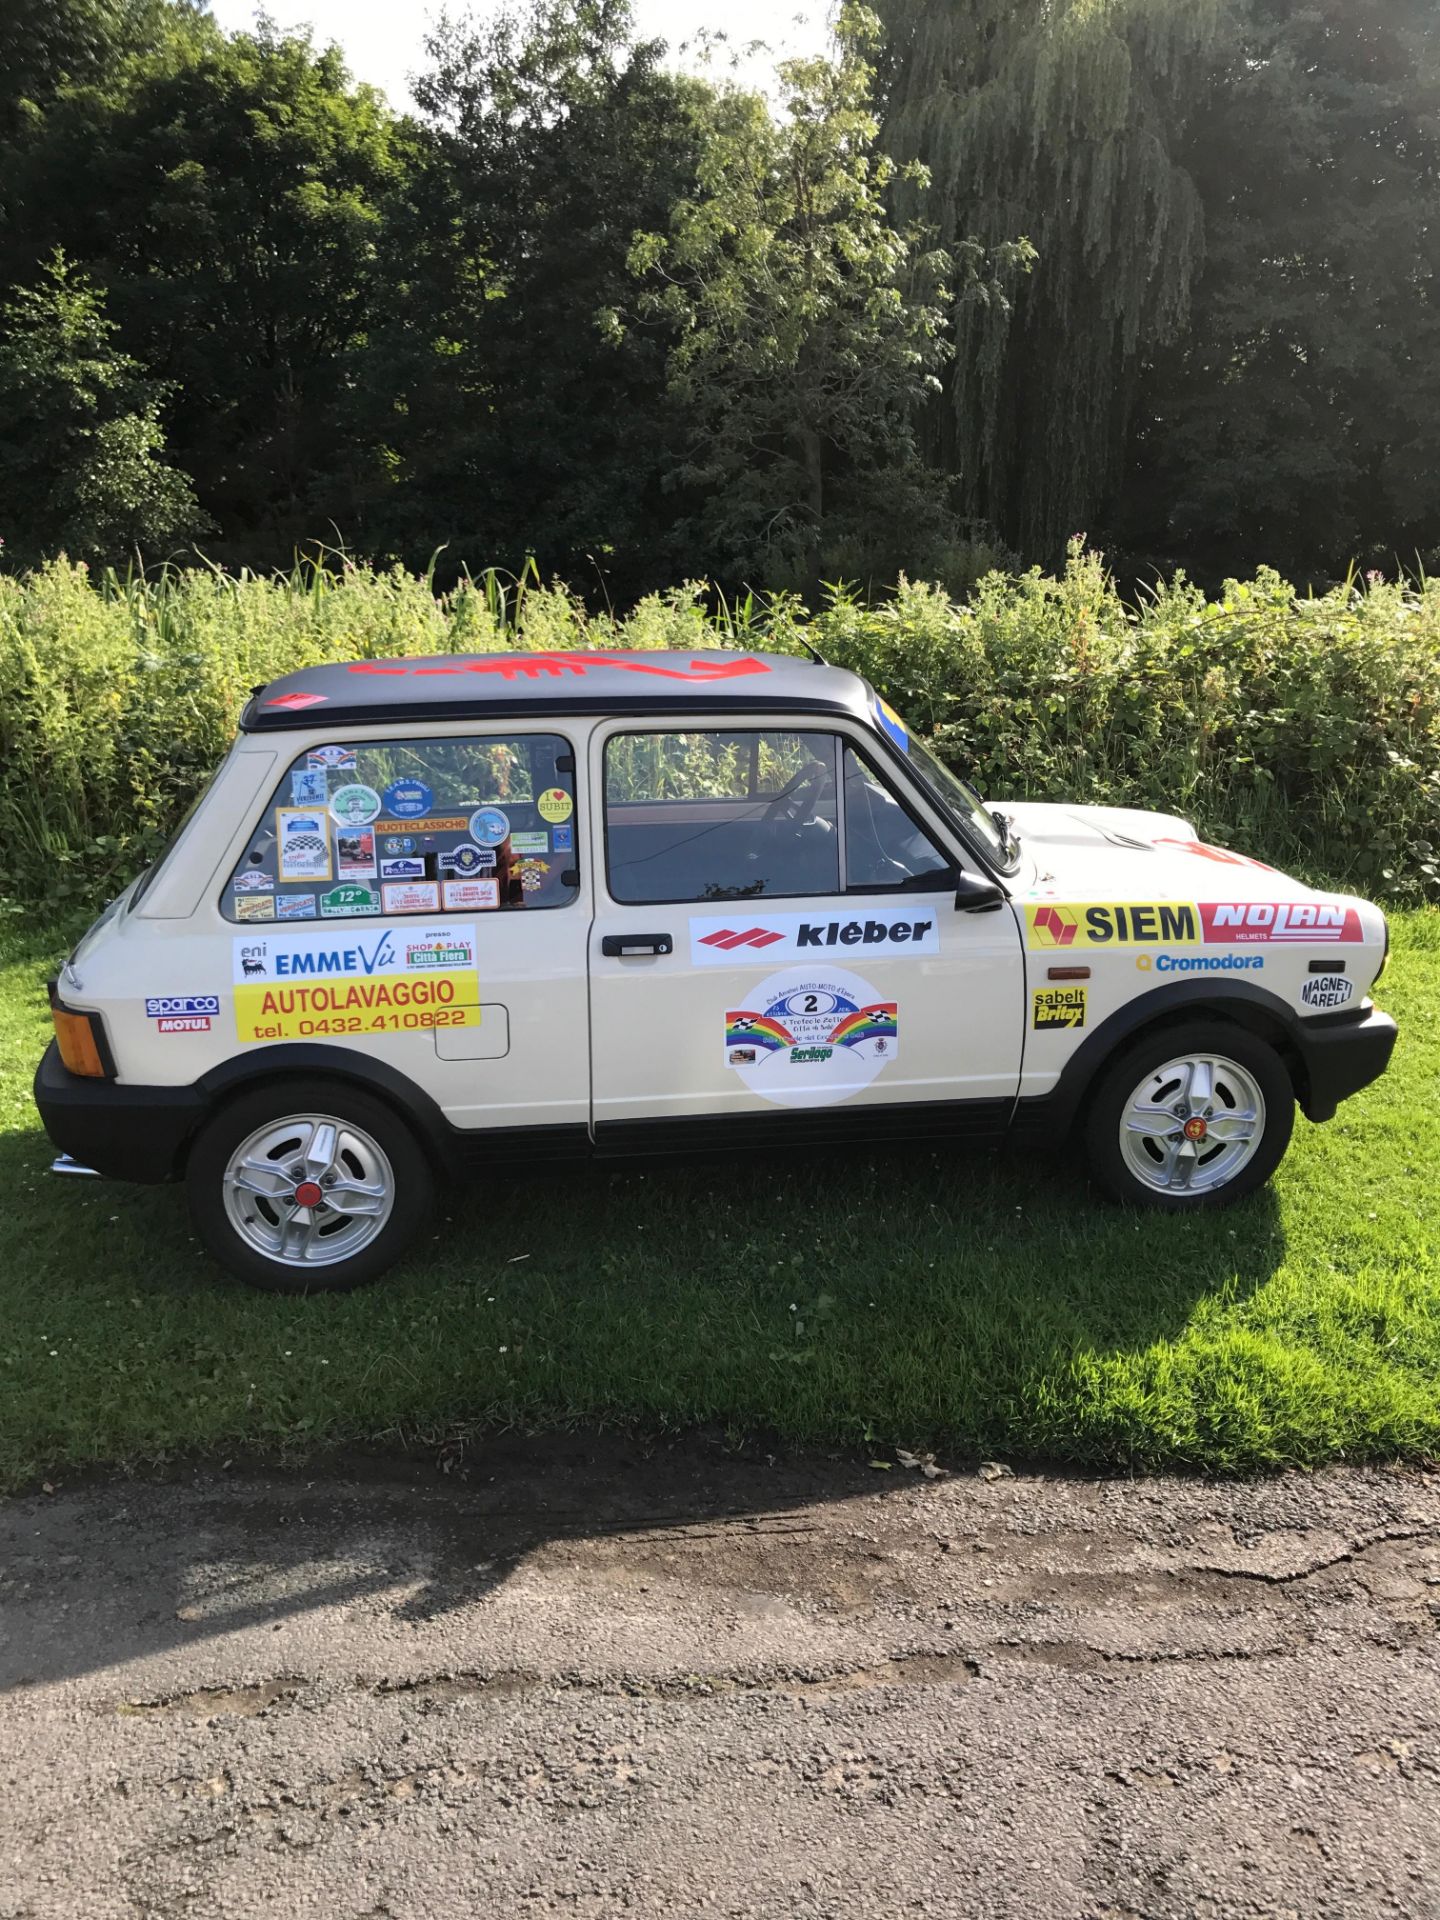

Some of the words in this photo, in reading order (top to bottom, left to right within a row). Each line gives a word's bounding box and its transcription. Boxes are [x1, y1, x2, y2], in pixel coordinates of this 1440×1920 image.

[544, 792, 551, 802] I
[540, 802, 571, 811] SUBIT
[376, 820, 466, 832] RUOTECLASSICHE
[1086, 906, 1196, 943] SIEM
[1212, 904, 1347, 934] NOLAN
[796, 920, 933, 947] kléber
[241, 942, 267, 957] eni
[406, 944, 433, 952] SHOP
[446, 941, 471, 949] PLAY
[413, 951, 438, 963] Città
[440, 950, 465, 961] Fiera
[1156, 954, 1265, 972] Cromodora
[261, 979, 455, 1015] AUTOLAVAGGIO
[804, 995, 818, 1012] 2
[1035, 989, 1085, 1005] sabelt
[147, 997, 217, 1015] sparco
[253, 1022, 289, 1039] tel.
[299, 1010, 466, 1036] 0432.410822
[1036, 1005, 1083, 1027] Britax
[160, 1019, 209, 1031] MOTUL
